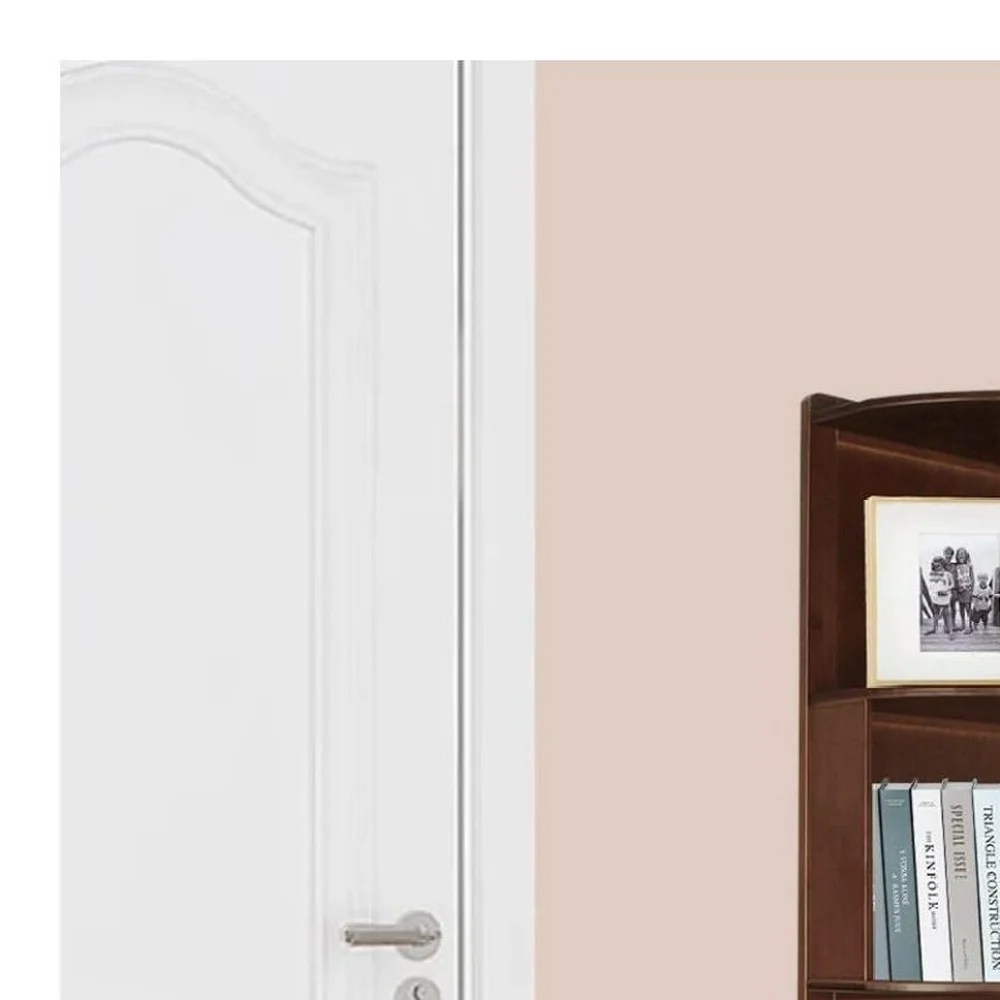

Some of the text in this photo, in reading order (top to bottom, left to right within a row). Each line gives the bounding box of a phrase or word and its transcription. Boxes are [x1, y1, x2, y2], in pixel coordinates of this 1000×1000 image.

[950, 804, 967, 846] SPECIAL
[983, 805, 997, 868] TRIANGLE
[924, 844, 939, 912] KINFOLK
